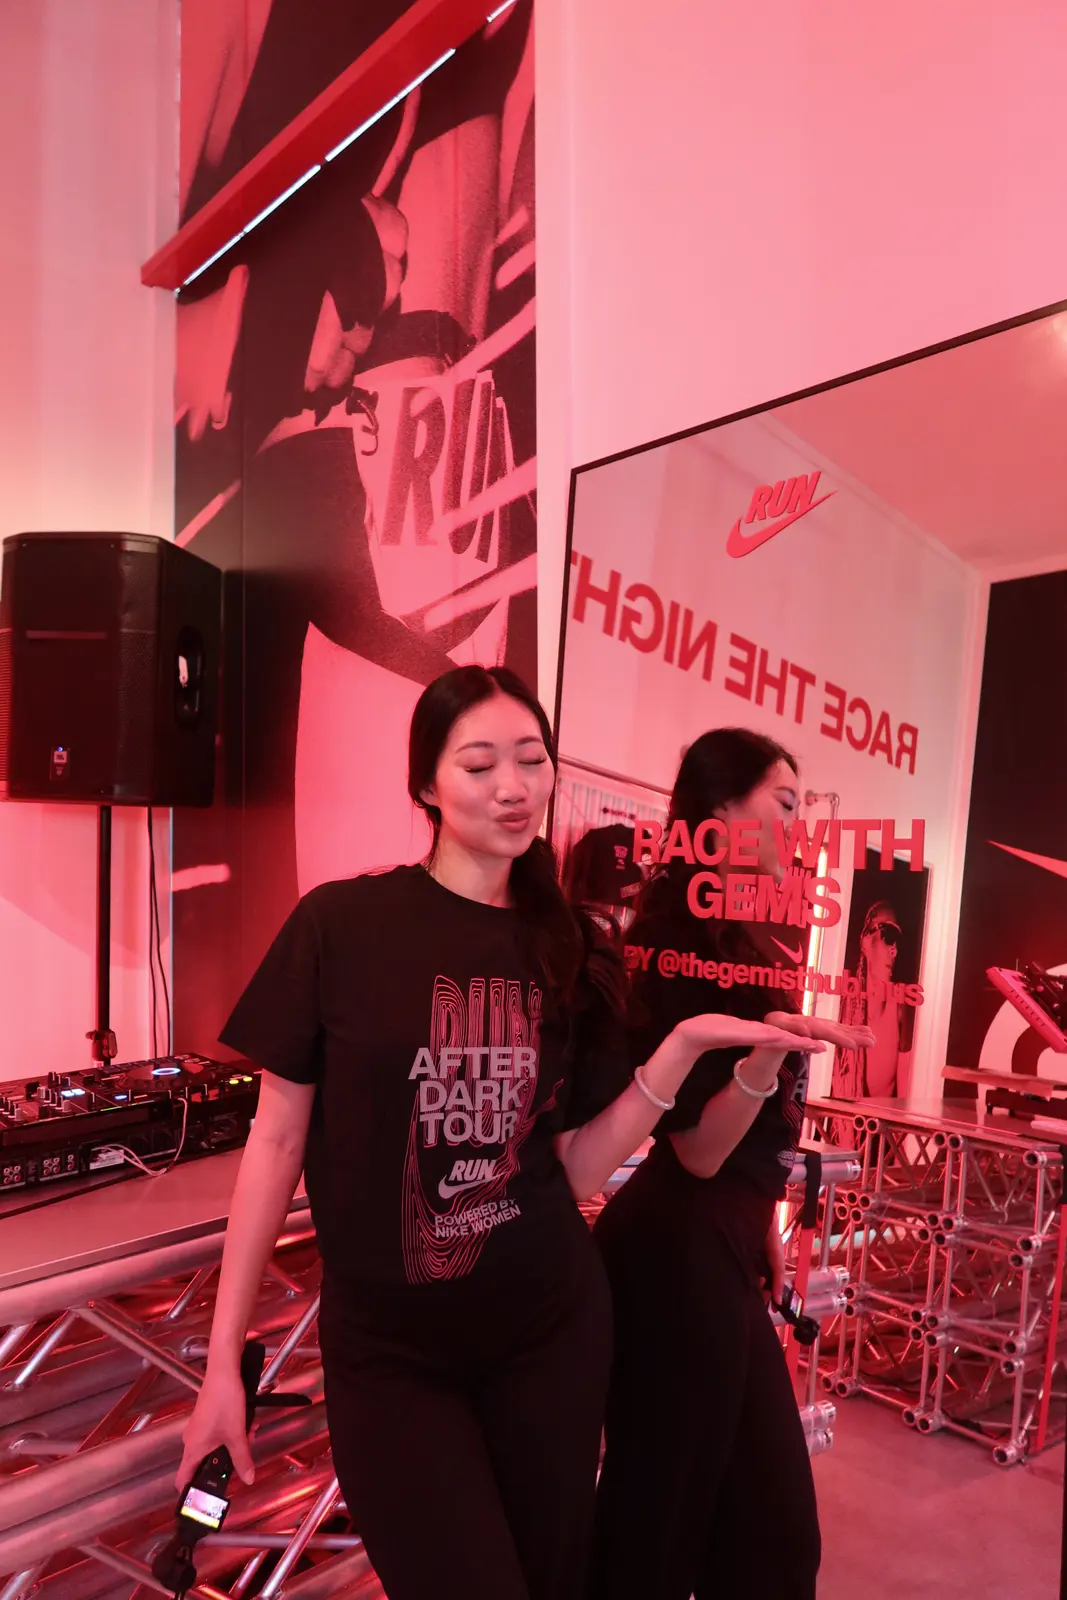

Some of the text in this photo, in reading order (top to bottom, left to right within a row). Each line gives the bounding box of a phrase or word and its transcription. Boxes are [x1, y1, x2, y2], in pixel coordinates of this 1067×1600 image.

[743, 470, 822, 524] RUN
[632, 818, 762, 867] RACE
[773, 819, 925, 871] WITH
[687, 871, 841, 928] GEMS
[623, 945, 655, 971] BY
[408, 1047, 537, 1080] AFTER
[419, 1079, 528, 1114] DARK
[419, 1110, 518, 1145] TOUR
[448, 1159, 497, 1182] RUN
[434, 1199, 517, 1227] POWERED BY
[435, 1205, 522, 1238] NIKE WOMEN
